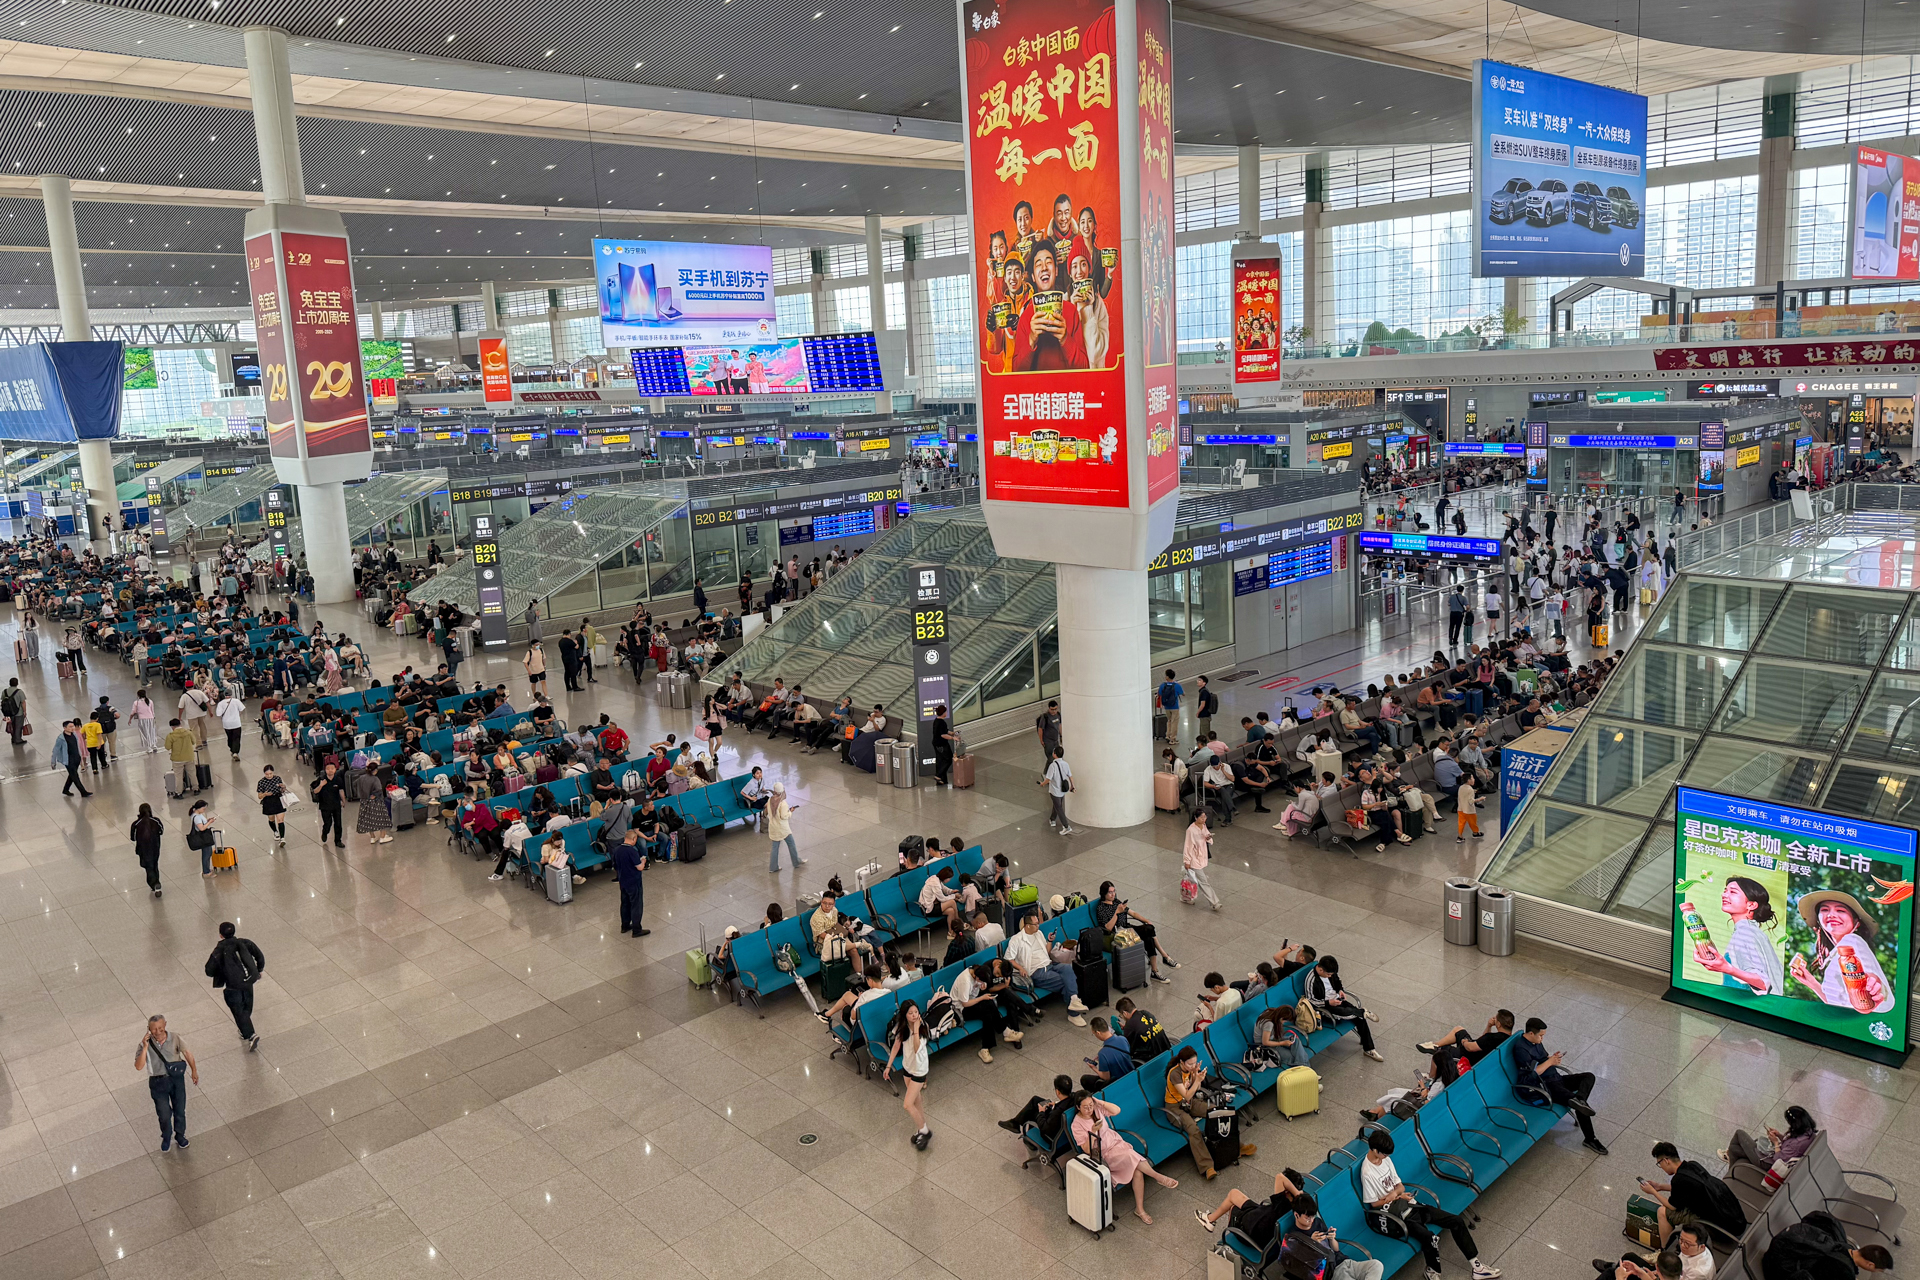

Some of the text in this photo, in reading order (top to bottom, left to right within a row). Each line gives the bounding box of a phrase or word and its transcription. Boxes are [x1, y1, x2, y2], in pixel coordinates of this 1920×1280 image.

[1002, 26, 1080, 67] 白象中国面
[976, 52, 1112, 138] 温暖中国
[995, 120, 1099, 186] 每一面
[678, 268, 769, 288] 买手机到苏宁
[1236, 278, 1278, 292] 温暖中国
[300, 289, 343, 309] 兔宝宝
[1242, 292, 1274, 305] 每一面
[296, 310, 351, 325] 上市20周年
[1685, 343, 1916, 368] 文明出行 让流动的
[266, 363, 287, 401] 20
[307, 361, 353, 400] 20
[1811, 383, 1859, 391] CHAGEE
[1003, 391, 1103, 420] 全网销额第一
[1387, 393, 1398, 402] 3F
[1678, 437, 1693, 445] A23
[206, 467, 235, 476] B14 B15
[452, 491, 471, 501] B18
[474, 488, 492, 499] B19
[695, 512, 715, 525] B20
[718, 510, 737, 522] B21
[867, 490, 884, 502] B20
[886, 488, 902, 500] B21
[268, 512, 284, 520] B18
[269, 519, 285, 527] B19
[1171, 547, 1193, 566] B23
[1327, 516, 1344, 532] B22
[1346, 512, 1363, 528] B23
[474, 543, 497, 554] B20
[475, 553, 497, 564] B21
[917, 588, 940, 597] 检票口
[915, 610, 944, 625] B22
[916, 624, 945, 640] B23
[1507, 753, 1546, 774] 流汗
[1683, 818, 1872, 874] 星巴克茶咖 全新上市
[1683, 839, 1738, 861] 好茶好咖啡
[1746, 852, 1774, 870] 低糖
